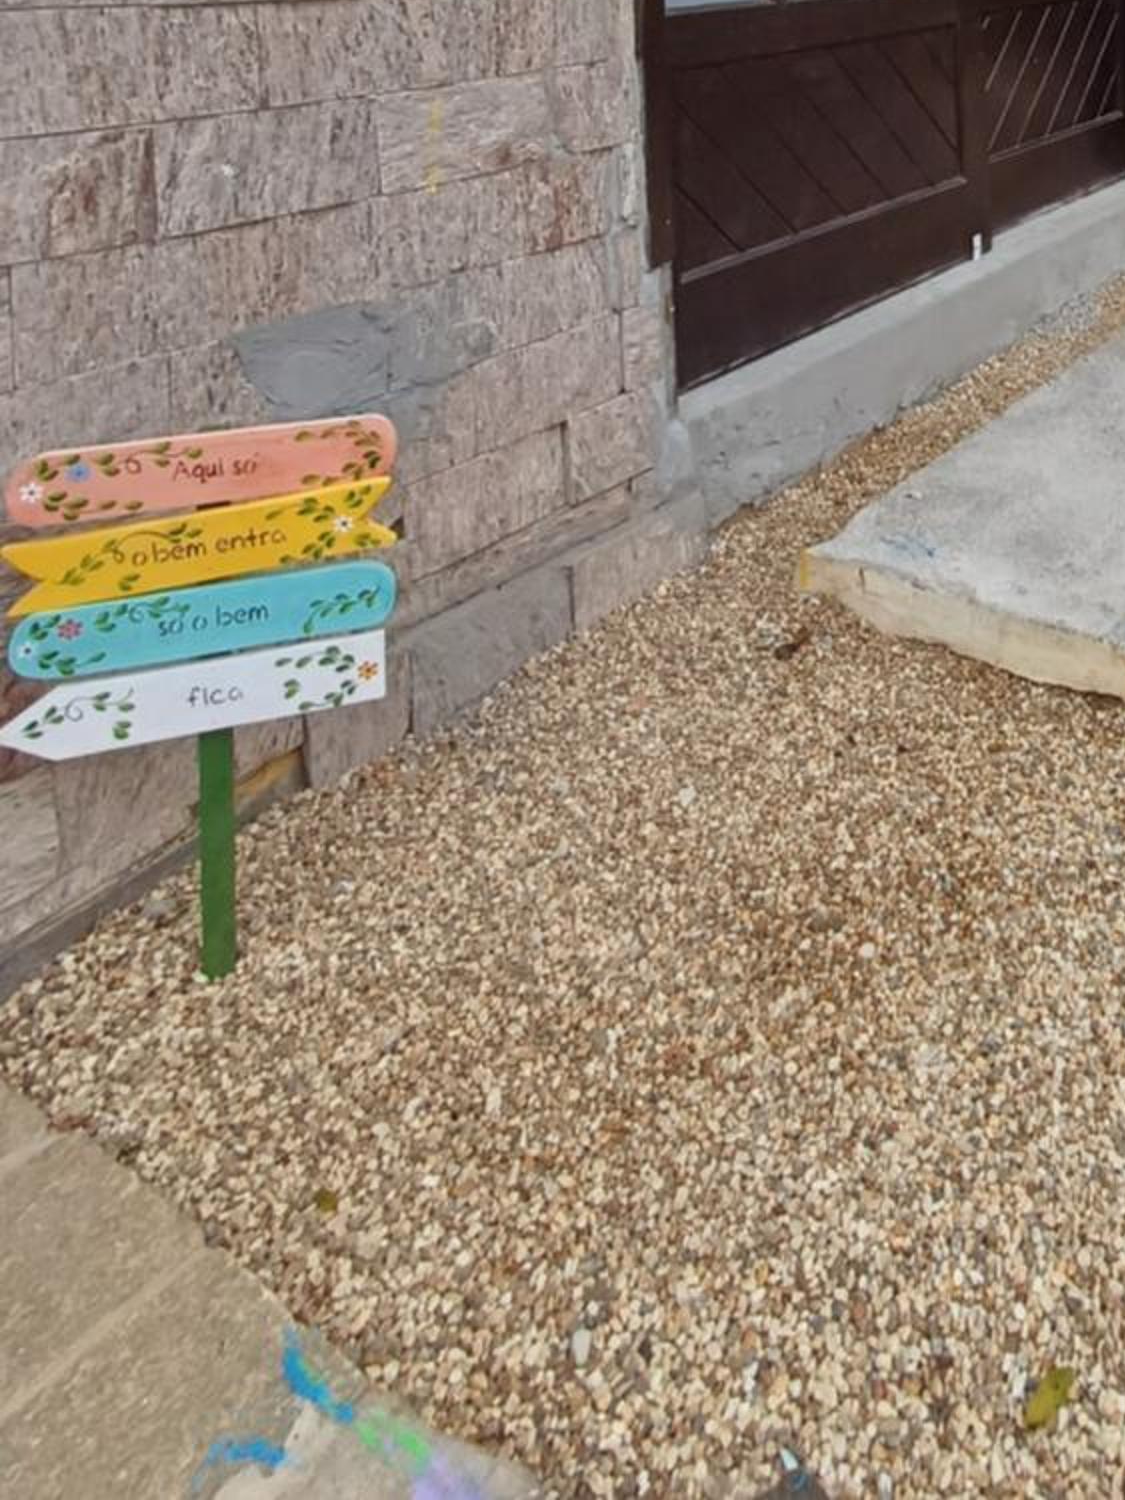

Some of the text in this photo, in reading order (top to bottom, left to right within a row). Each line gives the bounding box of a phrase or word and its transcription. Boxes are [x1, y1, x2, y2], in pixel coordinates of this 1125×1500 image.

[152, 542, 207, 563] bem
[215, 527, 287, 553] entra
[192, 614, 208, 631] o
[216, 604, 269, 627] bem
[187, 685, 244, 708] fica
